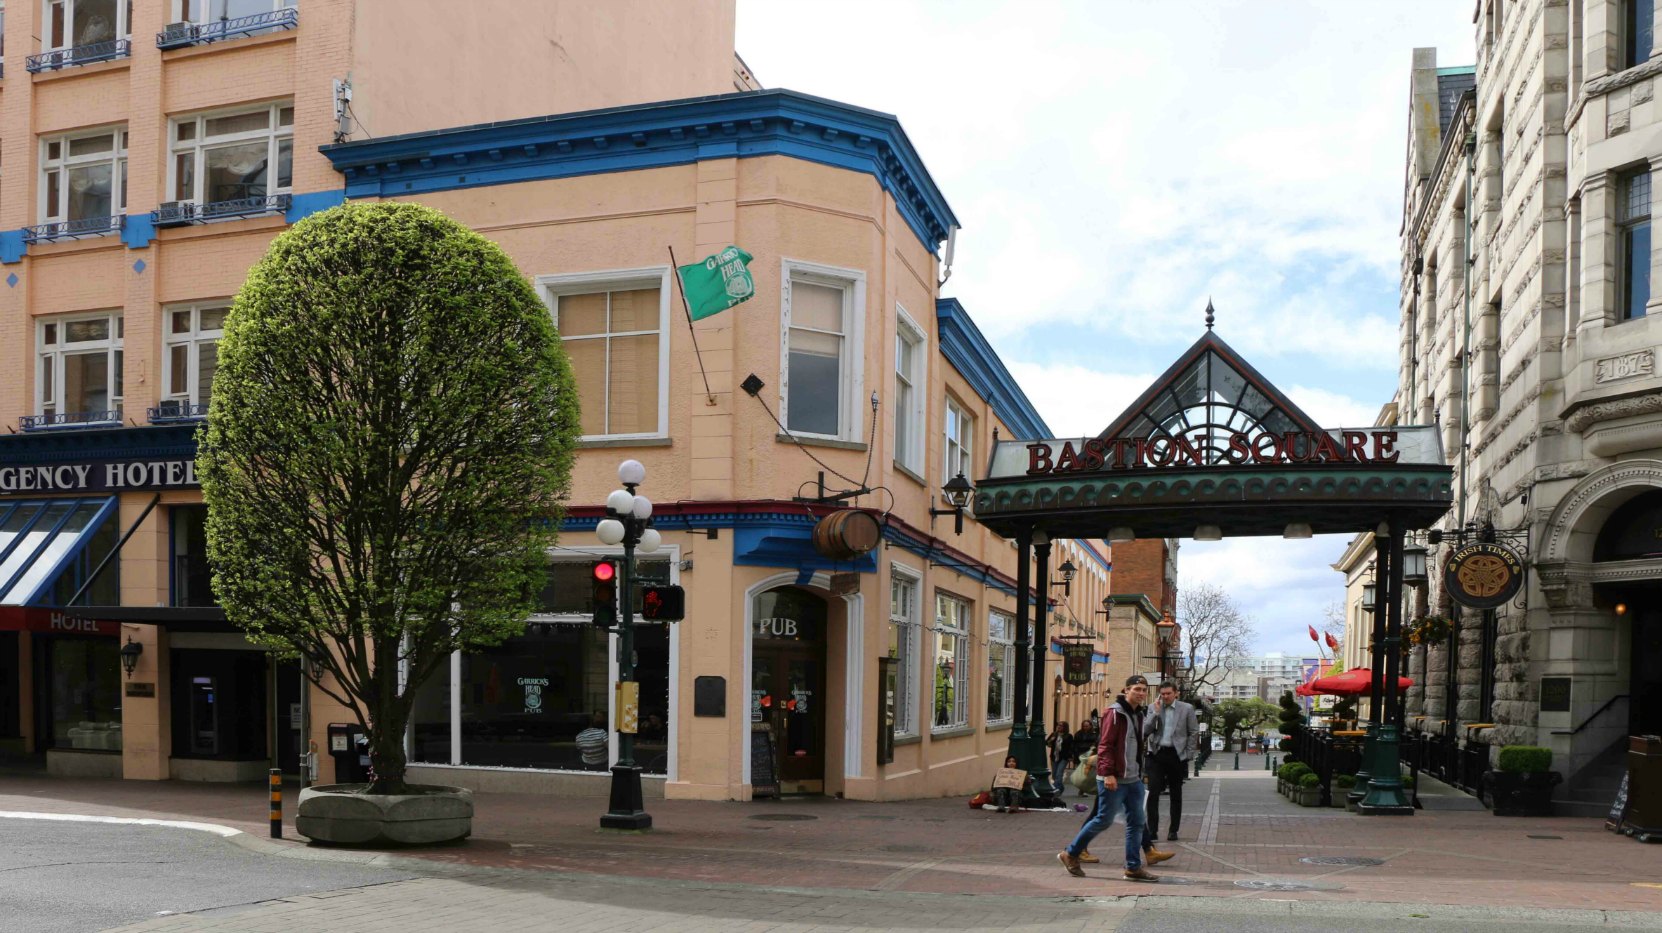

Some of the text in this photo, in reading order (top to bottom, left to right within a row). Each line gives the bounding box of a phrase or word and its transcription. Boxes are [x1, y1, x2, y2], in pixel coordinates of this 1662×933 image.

[721, 259, 746, 283] HEAD
[1026, 431, 1400, 475] BASTION SQUARE
[104, 460, 200, 487] HOTEL
[1454, 545, 1516, 565] IRISH TIMES
[50, 612, 100, 632] HOTEL
[759, 617, 798, 636] PUB
[525, 685, 542, 696] HEAD
